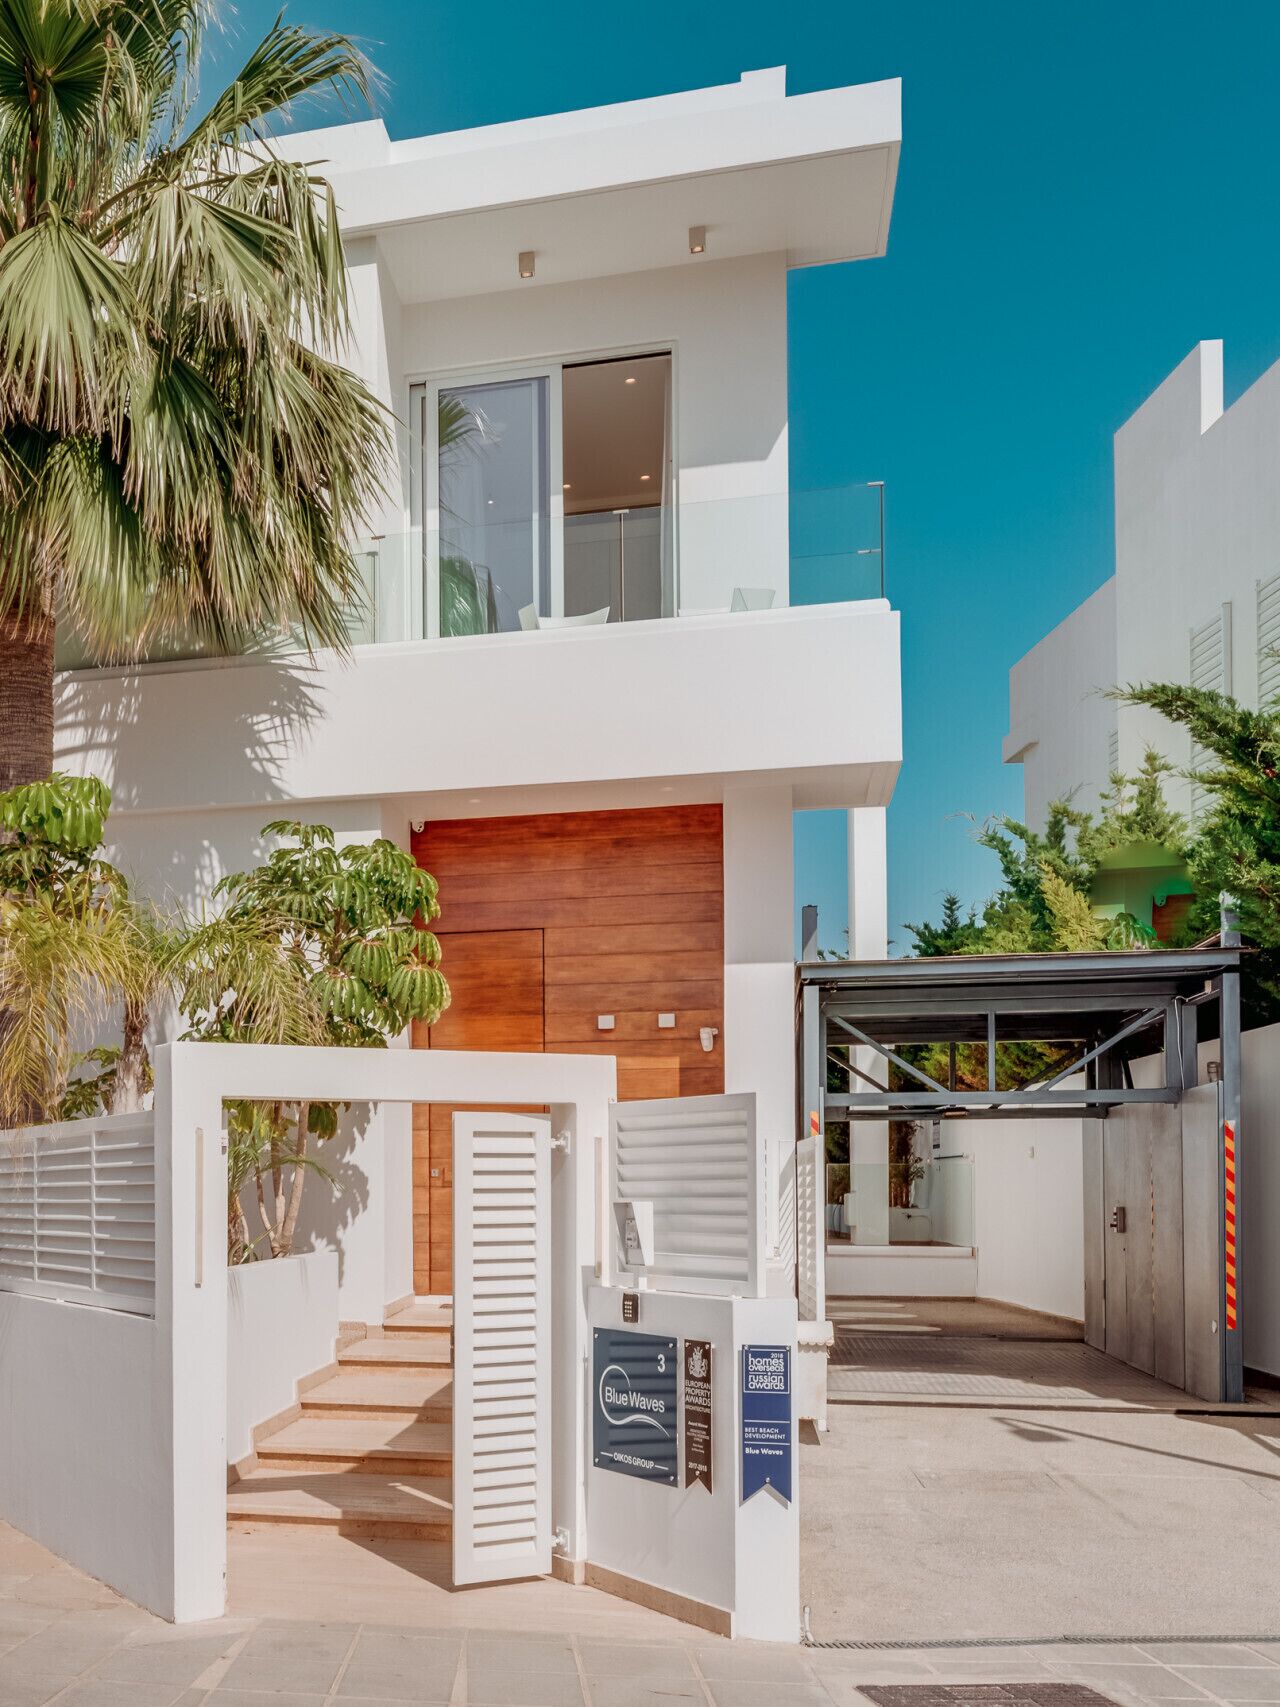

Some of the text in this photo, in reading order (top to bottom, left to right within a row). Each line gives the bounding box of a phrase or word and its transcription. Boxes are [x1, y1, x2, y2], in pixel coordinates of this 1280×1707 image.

[657, 1353, 666, 1373] 3
[748, 1353, 785, 1366] homes
[748, 1371, 784, 1383] russian
[685, 1379, 711, 1390] EUROPEAN
[748, 1382, 785, 1390] awards
[685, 1386, 711, 1398] PROPERTY
[605, 1386, 665, 1413] Blue Waves
[685, 1394, 711, 1407] AWARDS
[745, 1446, 784, 1456] Blue Waves
[613, 1452, 655, 1469] OIKOS GROUP
